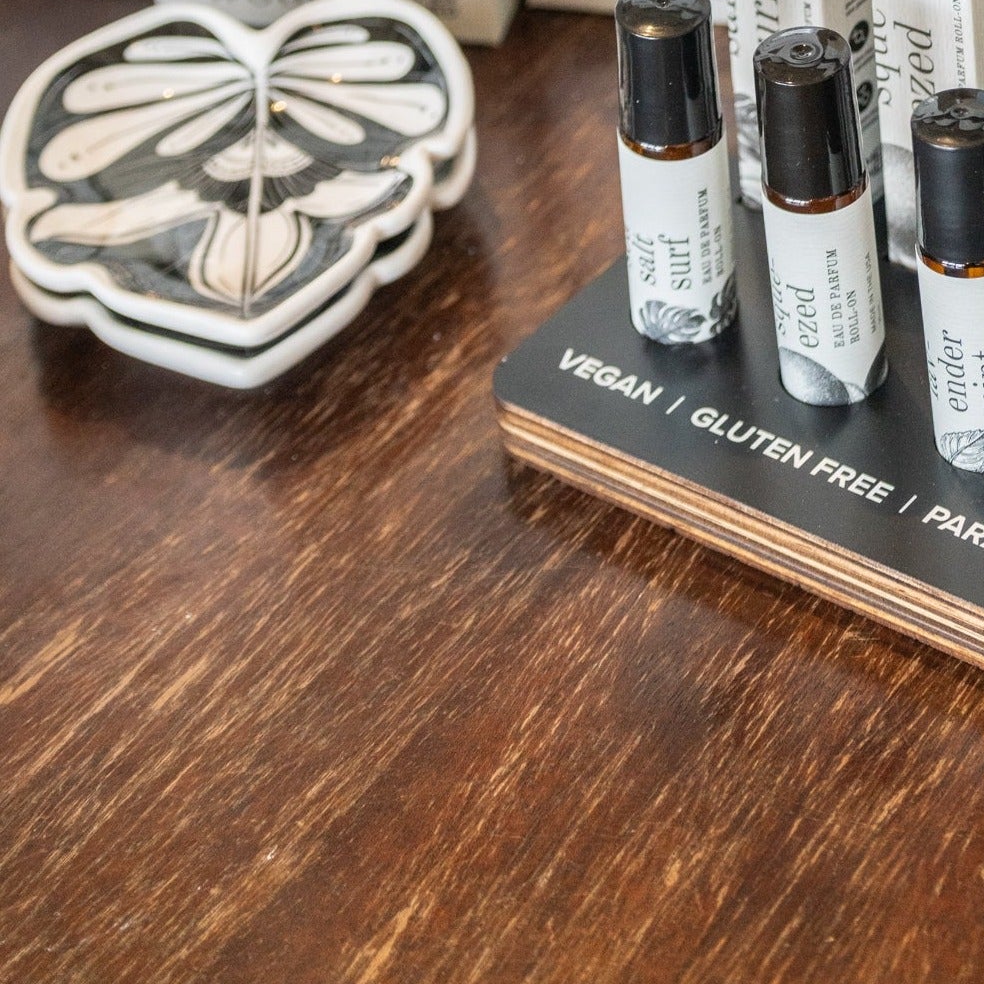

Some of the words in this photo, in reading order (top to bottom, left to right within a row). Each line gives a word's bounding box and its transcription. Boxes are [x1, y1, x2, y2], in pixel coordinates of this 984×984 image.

[698, 188, 710, 238] PARFUM
[632, 233, 656, 286] salt
[658, 234, 692, 291] surf
[826, 248, 841, 300] PARFUM
[786, 283, 819, 349] ezed
[831, 303, 843, 320] DE
[832, 324, 844, 349] EAU
[846, 290, 860, 345] ROLL-ON
[937, 329, 968, 412] ender
[557, 348, 665, 406] VEGAN
[690, 406, 819, 470] GLUTEN
[809, 455, 895, 505] FREE
